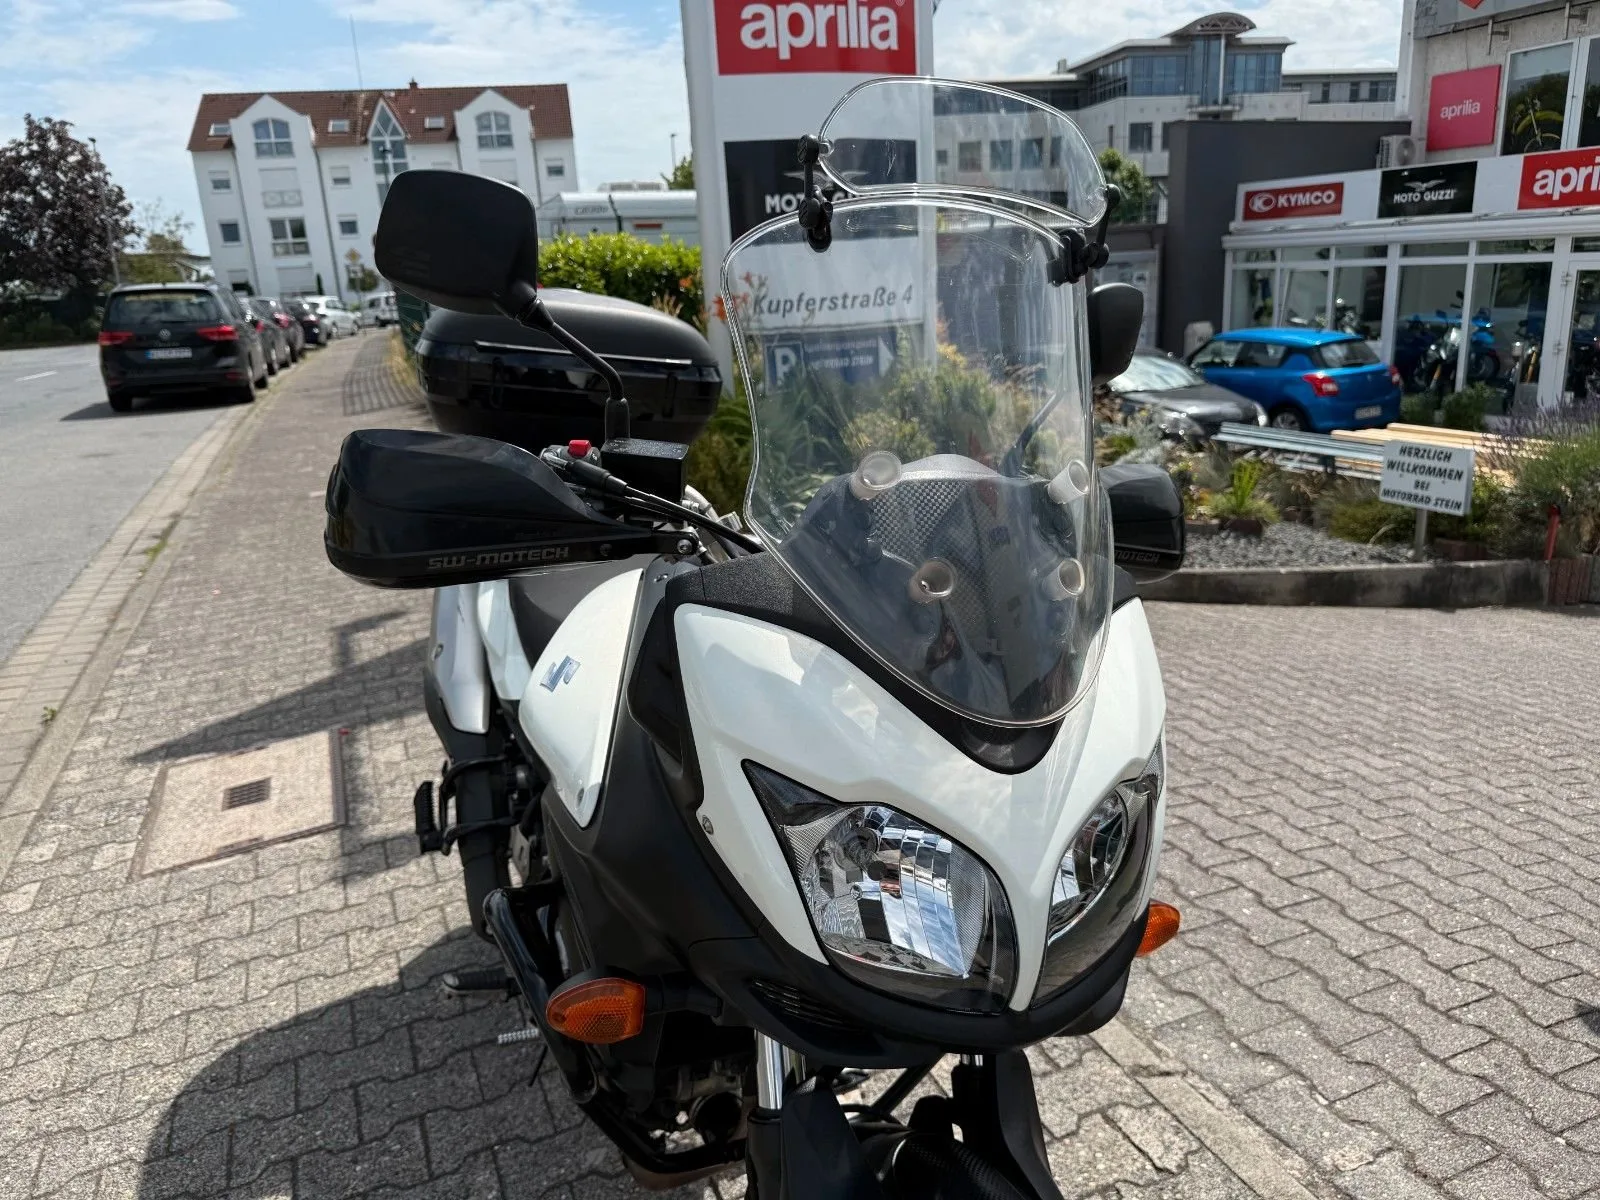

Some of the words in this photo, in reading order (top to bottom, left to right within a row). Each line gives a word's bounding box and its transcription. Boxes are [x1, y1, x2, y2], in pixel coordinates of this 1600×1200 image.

[740, 0, 898, 60] aprilia
[1440, 99, 1480, 120] aprilia
[1533, 155, 1600, 201] apri
[764, 193, 806, 215] MOT
[1277, 189, 1336, 208] KYMCO
[1393, 192, 1421, 204] MOTO
[1423, 188, 1455, 202] GUZZI
[753, 285, 897, 318] Kupferstraße
[901, 284, 914, 305] 4
[1399, 445, 1452, 463] HERZLICH
[1386, 459, 1464, 481] WILLKOMMEN
[1413, 479, 1431, 491] BEI
[1382, 488, 1431, 505] MOTORRAD
[1433, 497, 1462, 510] STEIN
[428, 547, 569, 569] SW-MOTECH
